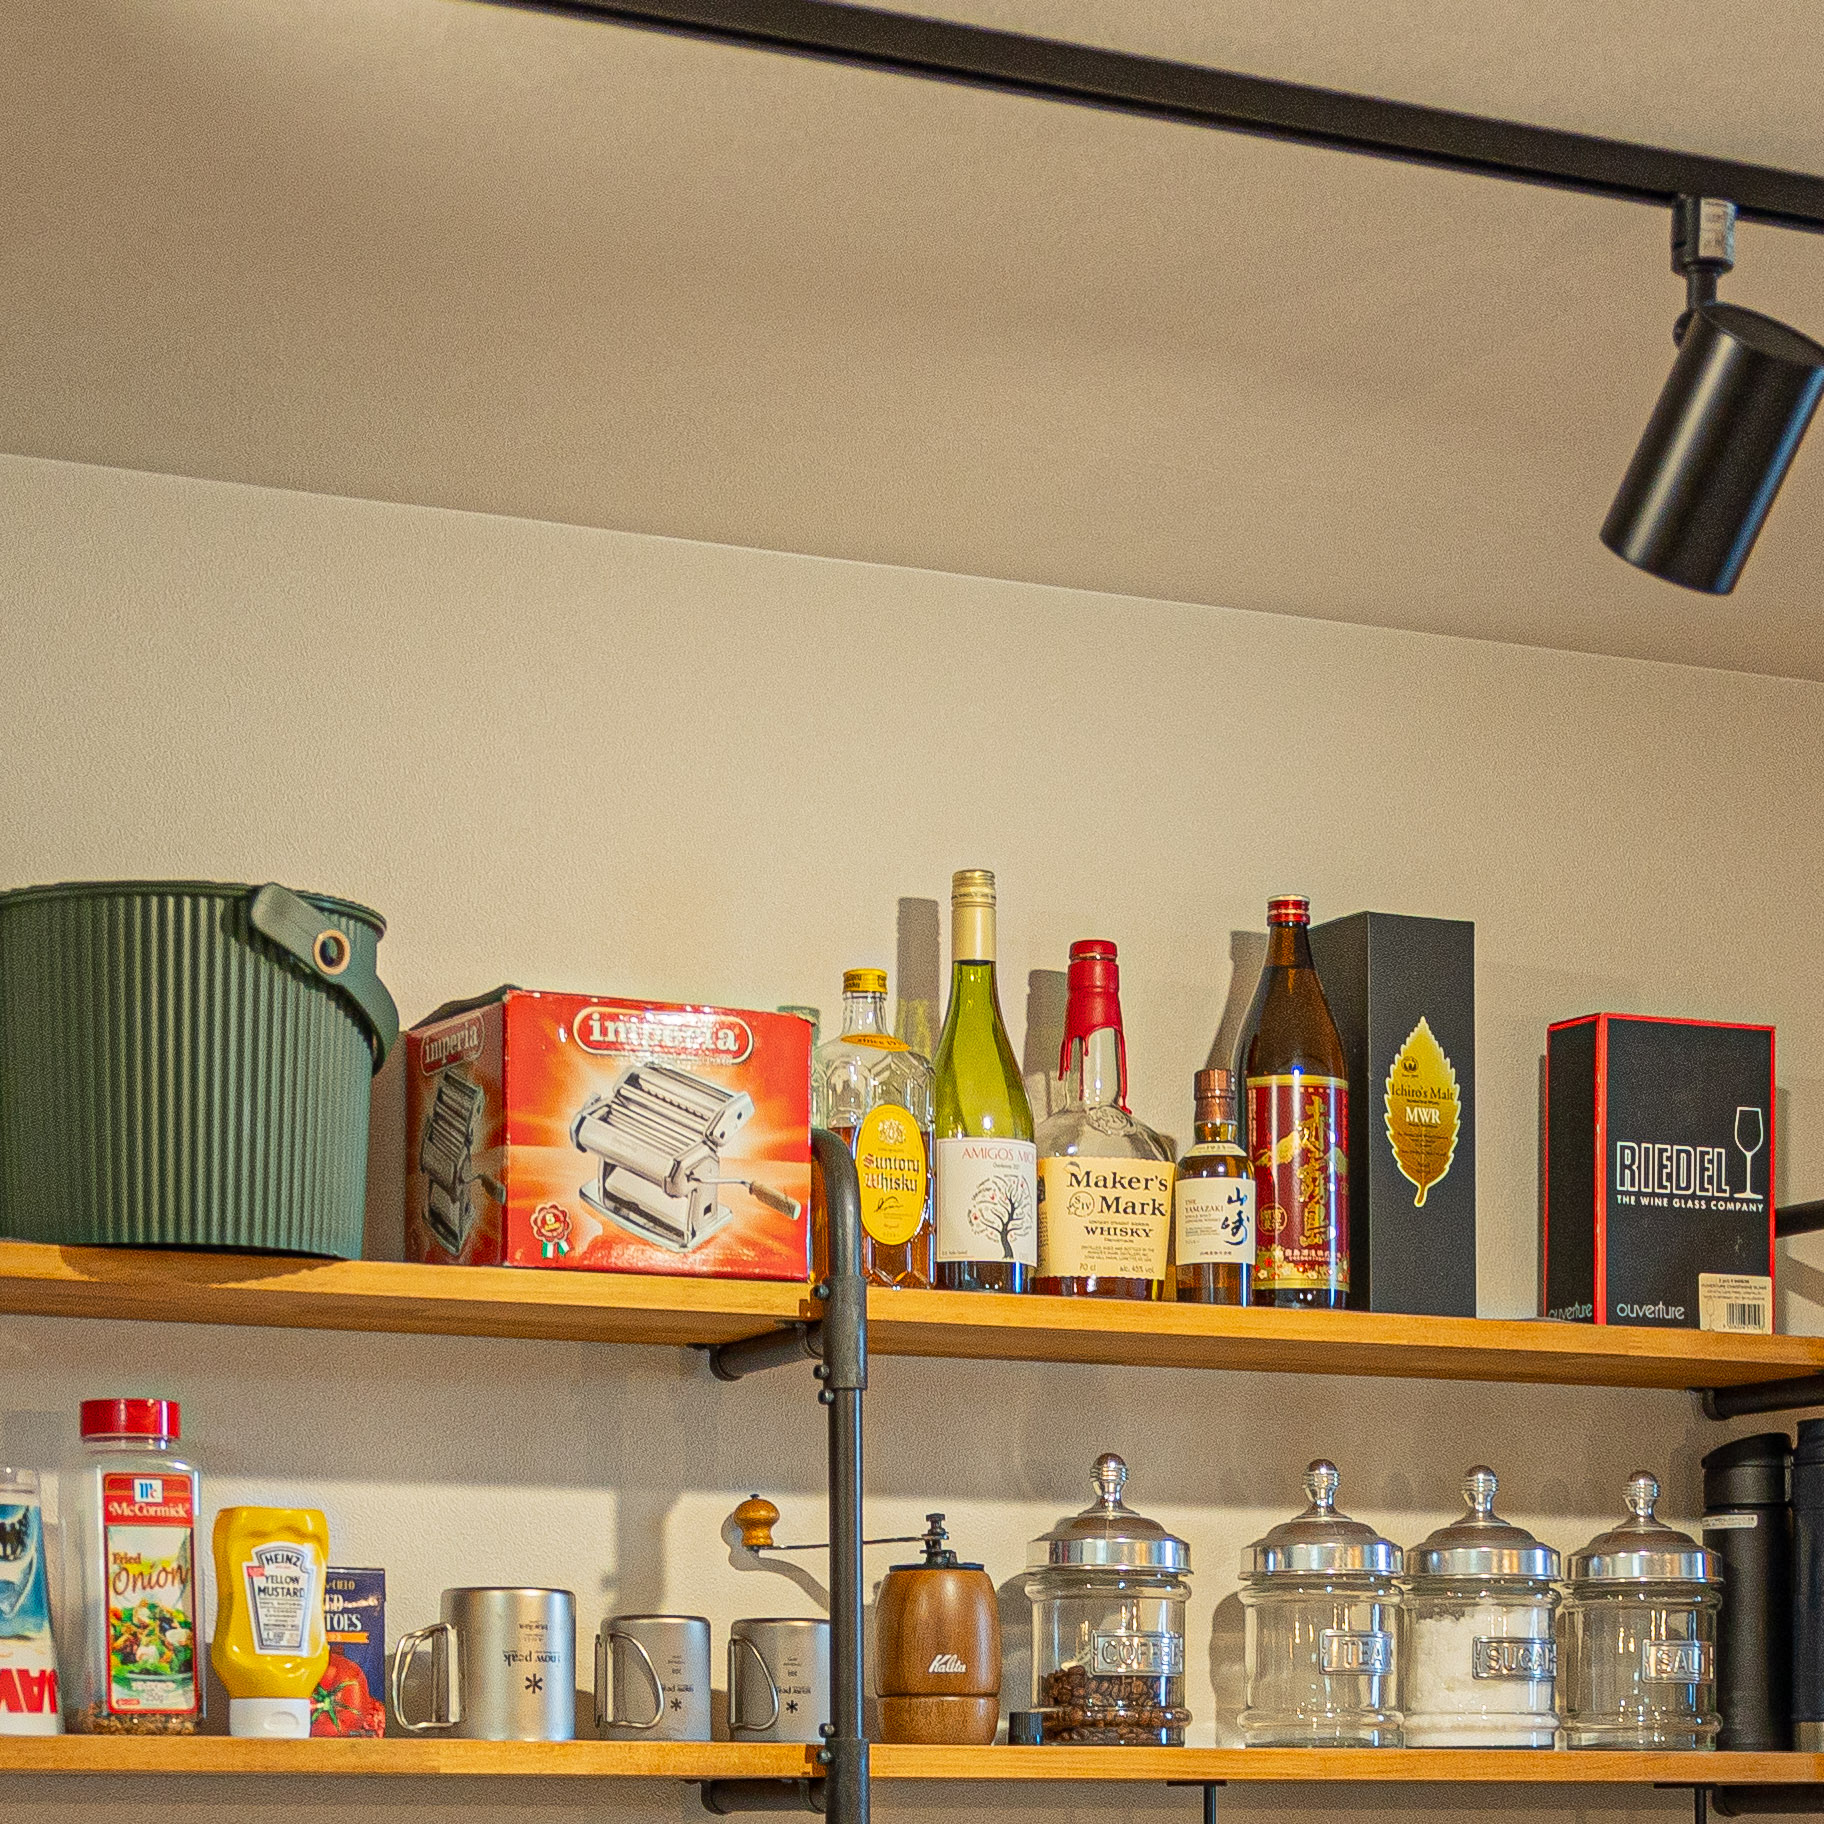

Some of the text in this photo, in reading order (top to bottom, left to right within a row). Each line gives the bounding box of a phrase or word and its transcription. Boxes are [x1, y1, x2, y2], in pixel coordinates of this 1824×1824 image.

[589, 1012, 739, 1051] imperia
[424, 1021, 479, 1066] imperia
[1391, 1083, 1454, 1101] Ichiro's Malt
[1406, 1106, 1441, 1124] MWR
[962, 1147, 1014, 1160] AMIGOS
[863, 1153, 920, 1174] Suntory
[1616, 1141, 1729, 1198] RIEDEL
[863, 1173, 918, 1194] Whisky
[1066, 1170, 1168, 1192] Maker's
[1097, 1195, 1166, 1217] Mark
[1616, 1194, 1764, 1213] THE WINE GLASS COMPANY
[1084, 1225, 1154, 1238] WHISKY
[1616, 1301, 1685, 1320] ouverture
[107, 1502, 188, 1518] McCormick
[112, 1552, 142, 1565] Fried
[264, 1553, 301, 1567] HEINZ
[264, 1575, 301, 1585] YELLOW
[257, 1586, 305, 1598] MUSTARD
[1342, 1639, 1384, 1666] TEA
[928, 1654, 967, 1673] Kalita
